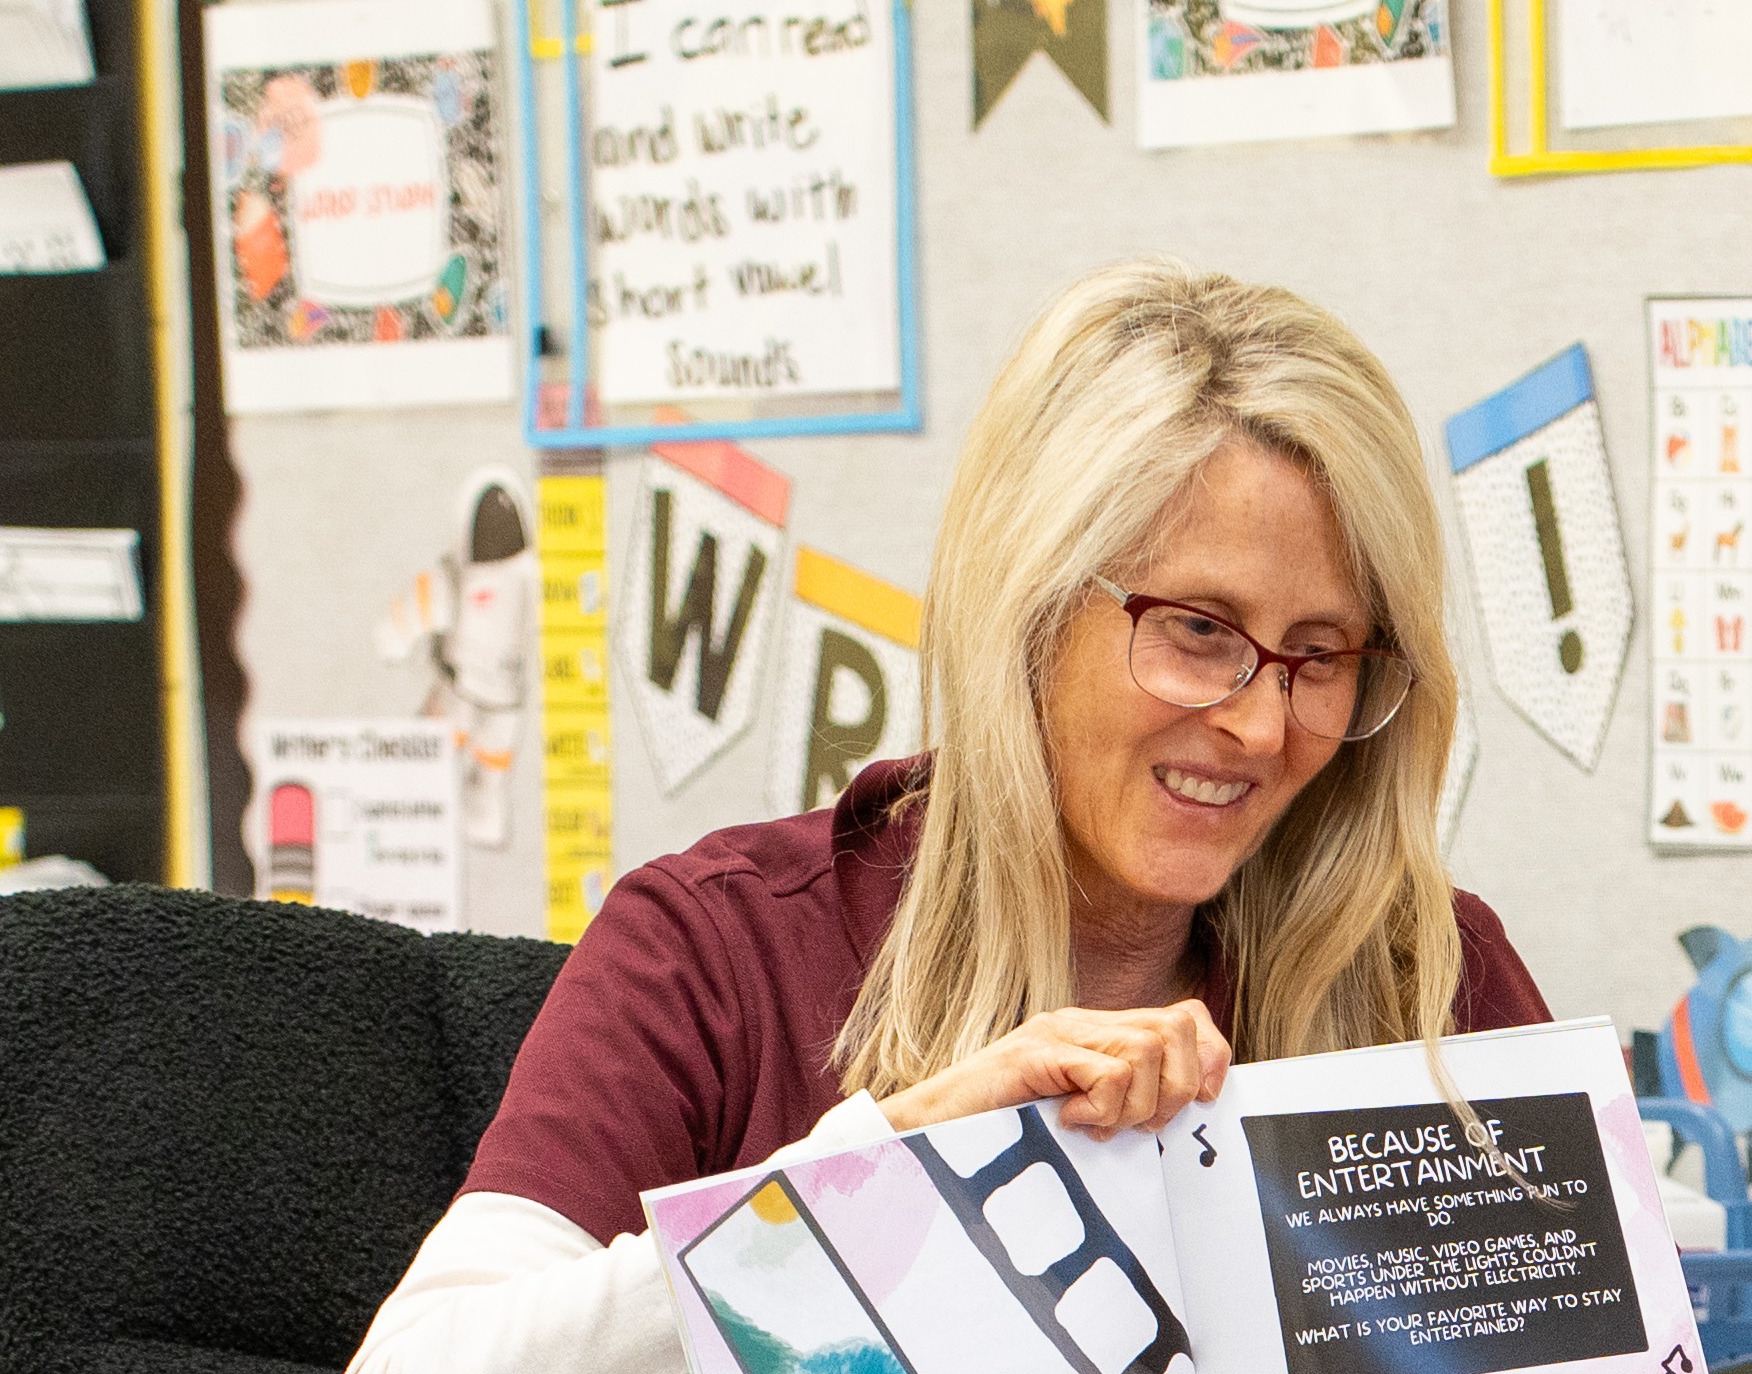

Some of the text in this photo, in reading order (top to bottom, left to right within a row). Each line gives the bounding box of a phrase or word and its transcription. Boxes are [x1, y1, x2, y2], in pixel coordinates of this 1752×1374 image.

[669, 16, 772, 60] can
[782, 1, 870, 58] read
[593, 92, 821, 167] and write
[593, 168, 856, 242] words with
[588, 240, 842, 327] short vowel
[645, 488, 768, 723] W
[803, 628, 887, 813] R
[1328, 1119, 1504, 1163] BECAUSE OF
[1298, 1145, 1545, 1199] ENTERTAINMENT
[1285, 1180, 1588, 1228] WE ALWAYS HAVE SOMETHING FUN TO
[1427, 1211, 1455, 1227] DO.
[1302, 1271, 1366, 1294] SPORTS
[1371, 1263, 1425, 1283] UNDER
[1429, 1258, 1461, 1276] THE
[1465, 1252, 1519, 1272] LIGHTS
[1307, 1229, 1577, 1276] MOVIES, MUSIC, VIDEO GAMES, AND
[1330, 1262, 1581, 1307] HAPPEN WITHOUT ELECTRICITY.
[1295, 1288, 1621, 1345] WHAT IS YOUR FAVORITE WAY TO STAY
[1410, 1317, 1525, 1345] ENTERTAINED?
